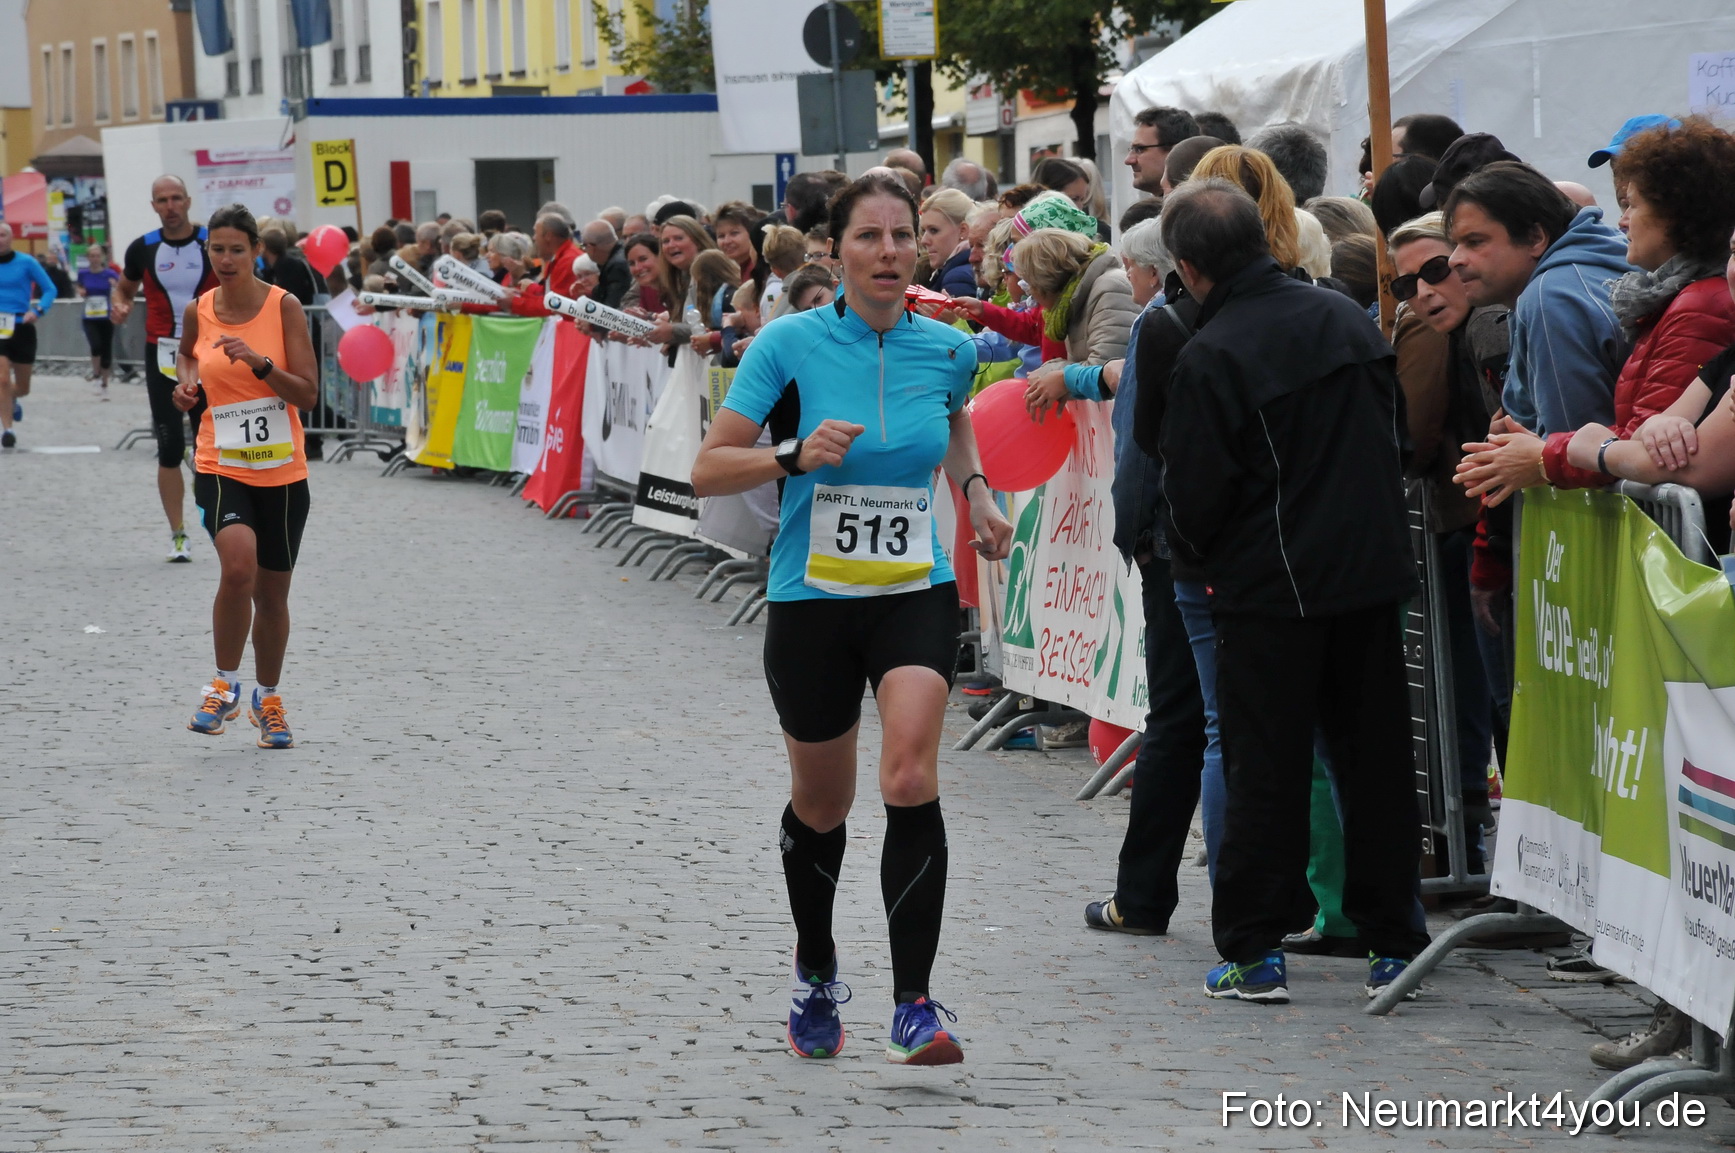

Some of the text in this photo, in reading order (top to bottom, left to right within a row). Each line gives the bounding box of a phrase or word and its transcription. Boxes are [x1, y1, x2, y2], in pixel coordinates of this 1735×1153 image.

[315, 142, 351, 156] Block
[324, 159, 348, 193] D
[214, 404, 276, 421] PARTL Neumarkt
[239, 416, 270, 444] 13
[240, 450, 273, 460] Milena
[816, 493, 913, 510] PARTL Neumarkt
[835, 511, 909, 557] 513
[1545, 530, 1565, 583] Der
[1038, 627, 1097, 688] BESSER
